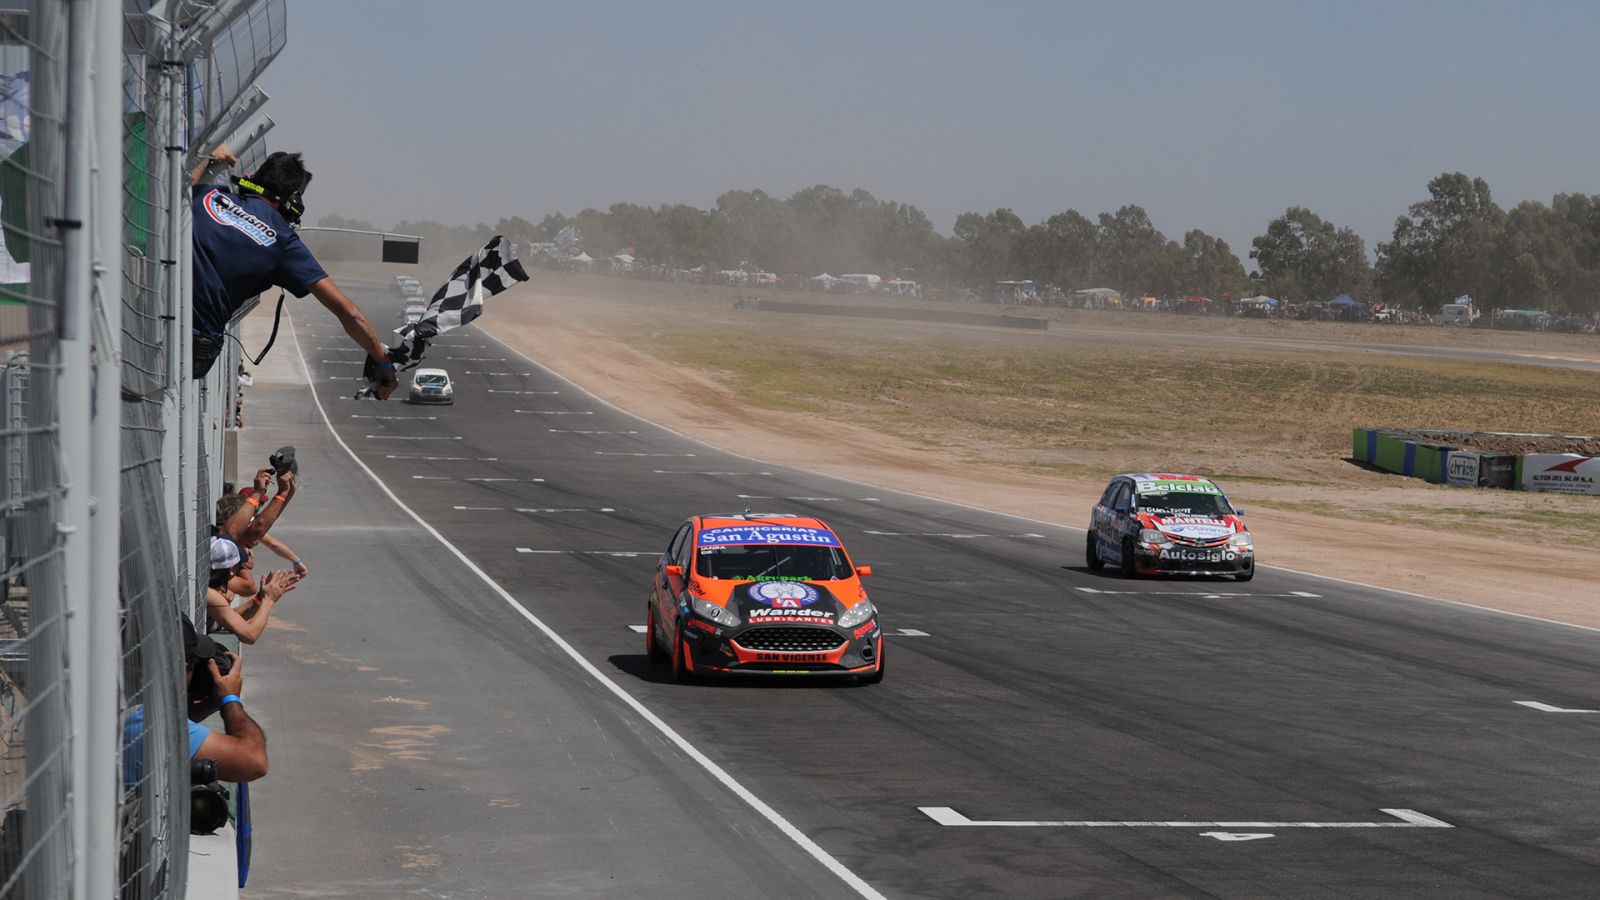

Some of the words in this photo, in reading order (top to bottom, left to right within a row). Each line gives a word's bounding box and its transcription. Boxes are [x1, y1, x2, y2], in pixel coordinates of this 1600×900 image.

[223, 211, 275, 245] nacional
[702, 532, 743, 543] San
[1159, 549, 1235, 563] Autosiglo
[750, 608, 834, 618] Wander
[749, 617, 834, 625] LUBRICANTES
[756, 653, 779, 661] SAN
[782, 653, 828, 662] VICENTE
